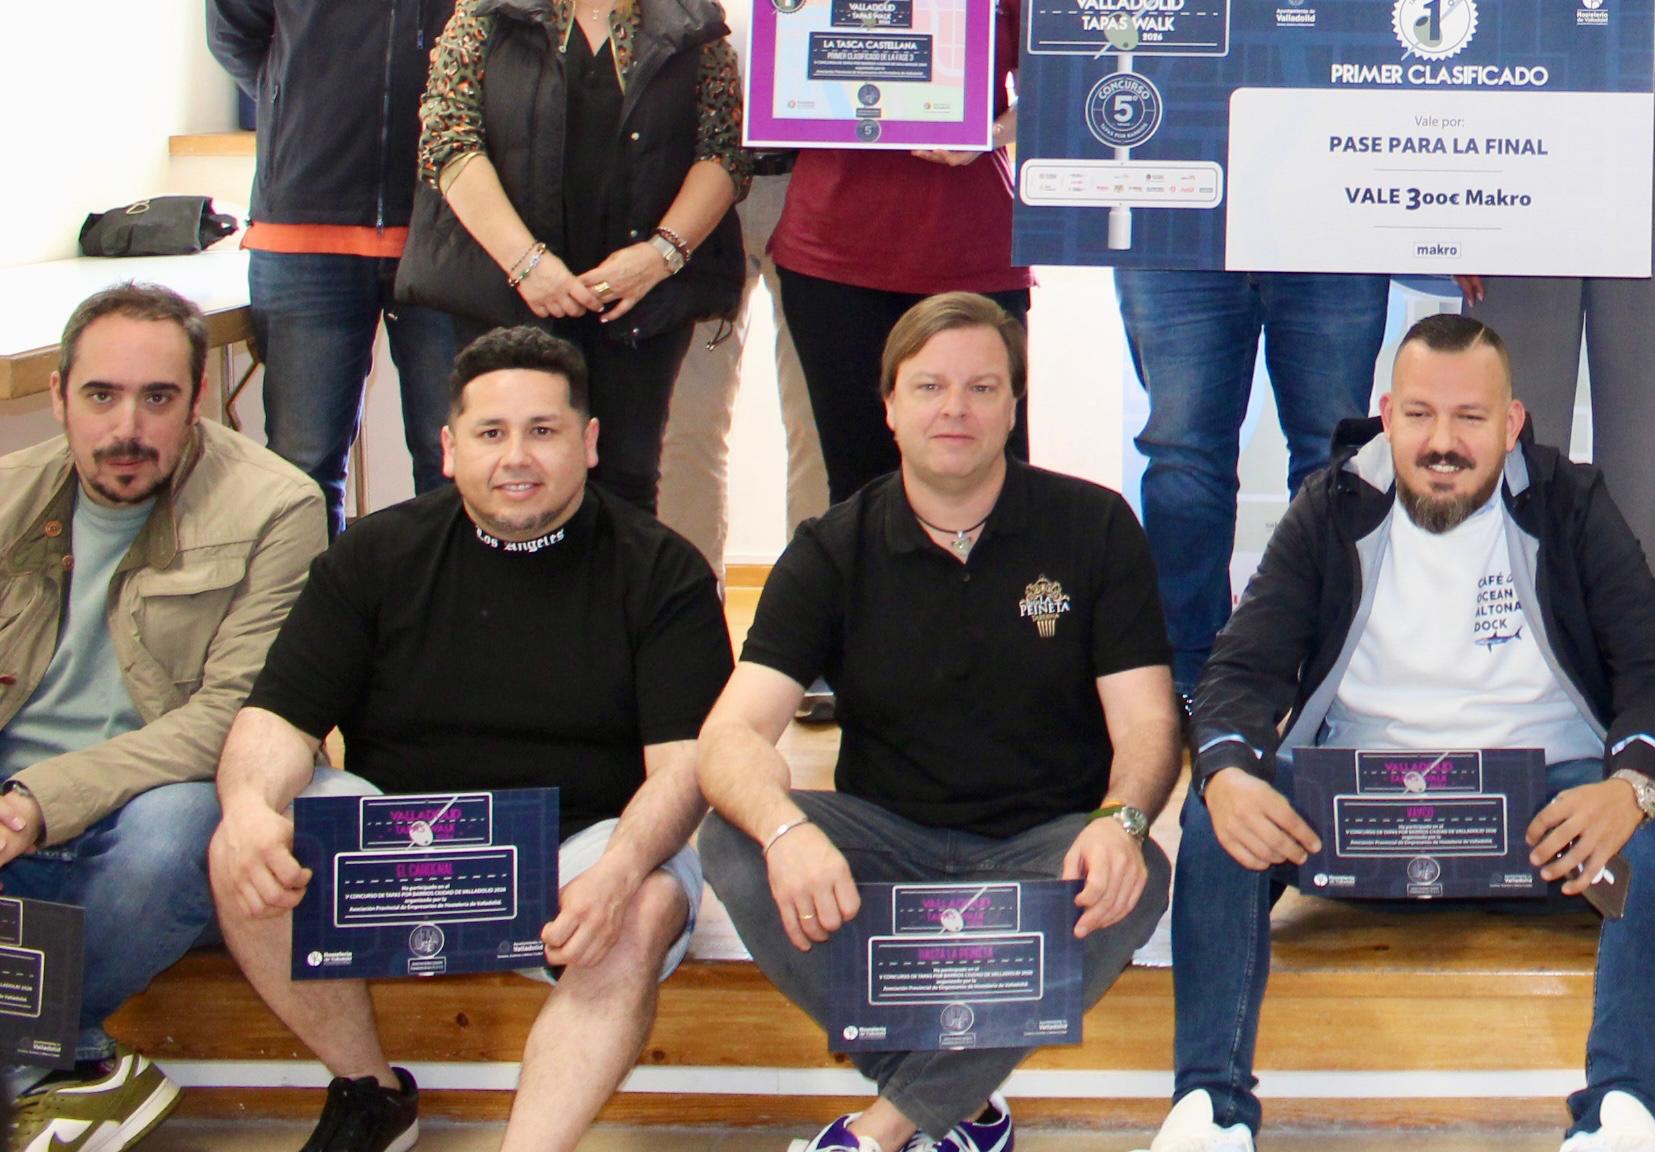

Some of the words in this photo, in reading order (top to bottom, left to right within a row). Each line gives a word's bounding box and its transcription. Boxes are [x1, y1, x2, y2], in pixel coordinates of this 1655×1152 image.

[1081, 15, 1128, 31] TAPAS
[1131, 16, 1175, 32] WALK
[1276, 14, 1316, 23] Valladolid
[823, 40, 834, 48] LA
[836, 40, 864, 49] TASCA
[865, 40, 917, 50] CASTELLANA
[1142, 33, 1163, 41] 2026
[1331, 64, 1403, 85] PRIMER
[1408, 65, 1549, 87] CLASIFICADO
[1098, 79, 1150, 100] CONCURSO
[1415, 115, 1439, 127] Vale
[1442, 116, 1465, 129] por:
[1329, 136, 1383, 153] PASE
[1388, 137, 1447, 154] PARA
[1453, 138, 1480, 155] LA
[1485, 138, 1548, 156] FINAL
[1345, 187, 1401, 204] VALE
[1406, 187, 1460, 210] 300€
[1465, 189, 1532, 206] Makro
[1417, 244, 1458, 255] makro
[475, 527, 499, 548] Los
[503, 528, 565, 553] Angeles
[1476, 588, 1513, 604] OCEAN
[1020, 601, 1071, 617] PEINETA
[1474, 600, 1522, 618] ALTONA
[1474, 618, 1508, 633] DOCK
